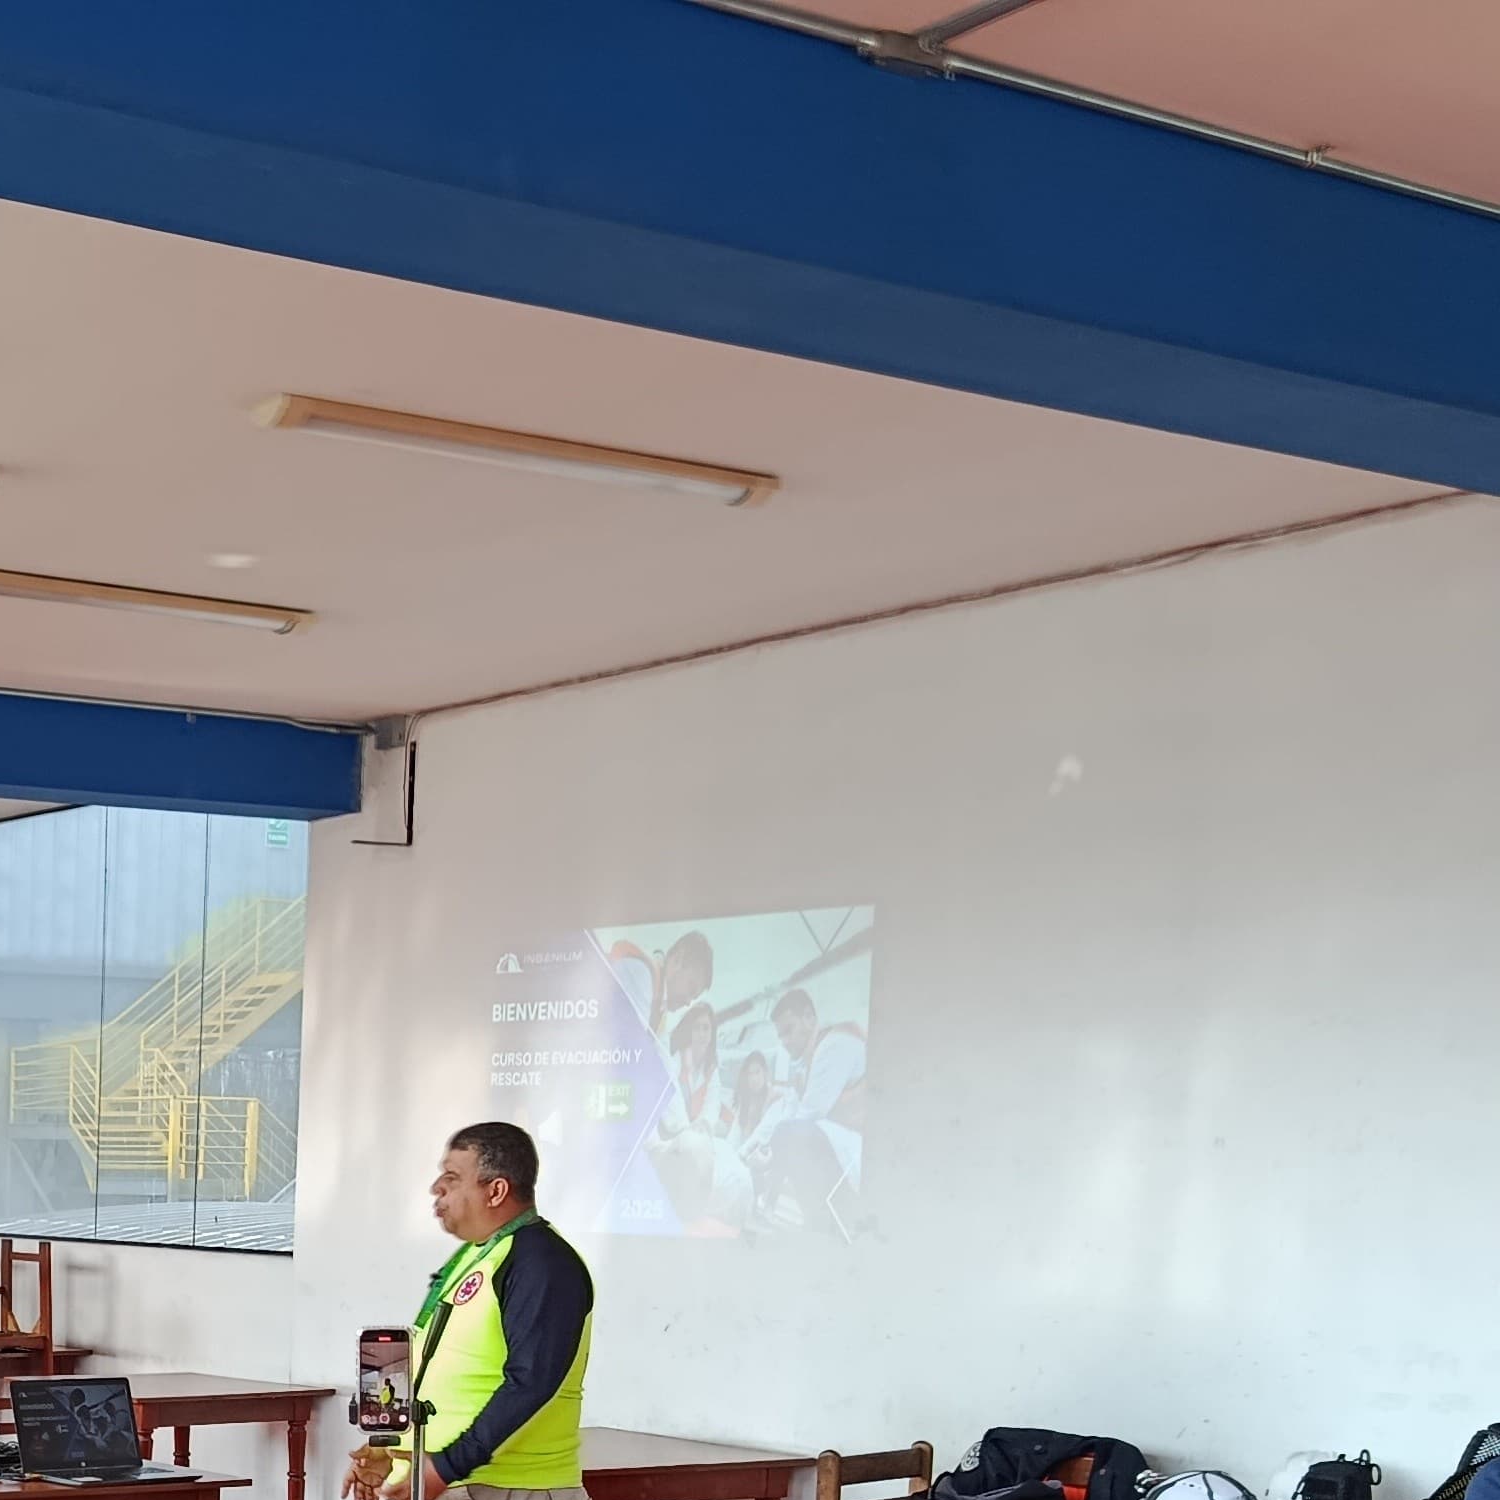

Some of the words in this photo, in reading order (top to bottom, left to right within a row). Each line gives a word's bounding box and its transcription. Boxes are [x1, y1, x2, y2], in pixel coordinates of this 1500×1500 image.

[492, 999, 598, 1022] BIENVENIDOS
[491, 1052, 532, 1067] CURSO
[534, 1051, 550, 1066] DE
[552, 1047, 630, 1066] EVACUACIÓN
[633, 1048, 643, 1063] Y
[491, 1071, 541, 1087] RESCATE
[608, 1084, 631, 1097] EXIT
